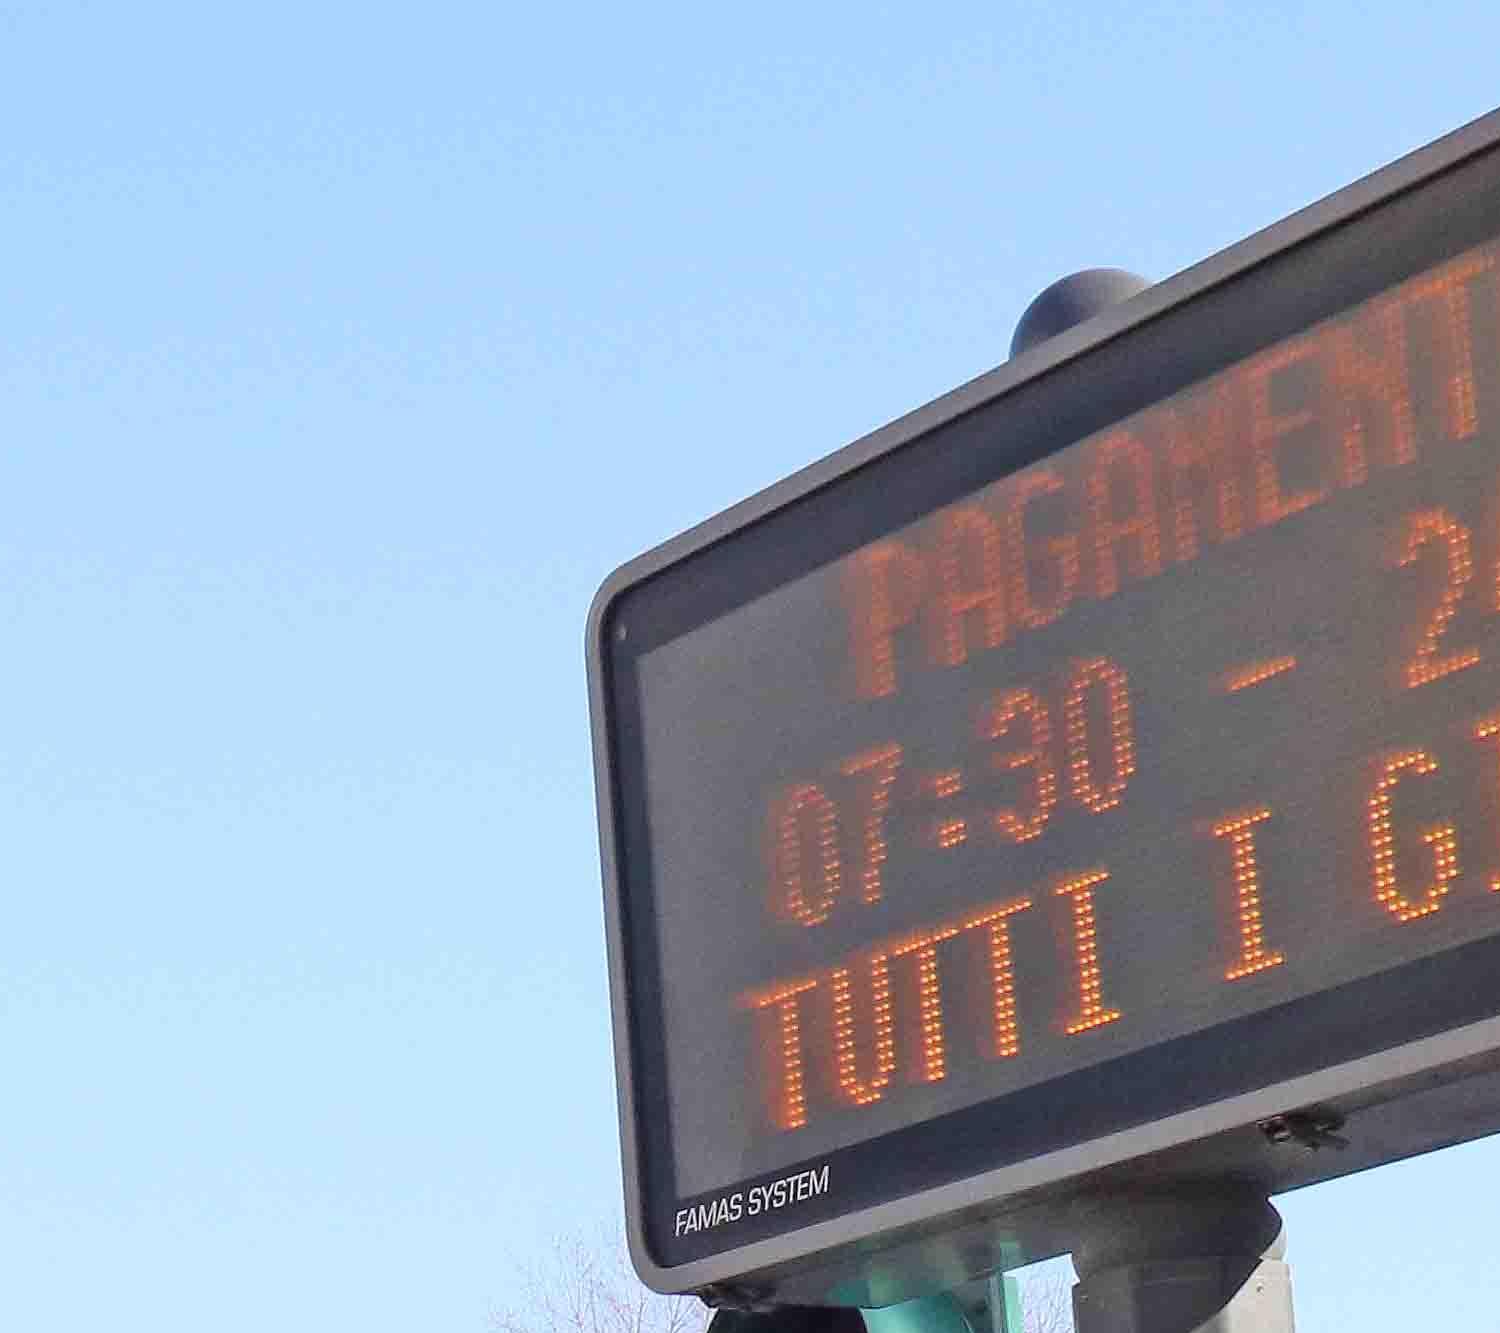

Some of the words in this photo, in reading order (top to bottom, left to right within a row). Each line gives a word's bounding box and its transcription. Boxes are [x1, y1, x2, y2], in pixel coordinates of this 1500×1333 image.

[765, 656, 1135, 928] 07:30
[738, 871, 1119, 1131] TUTTI
[1212, 810, 1288, 982] I
[675, 1192, 743, 1237] FAMAS
[748, 1165, 830, 1216] SYSTEM
